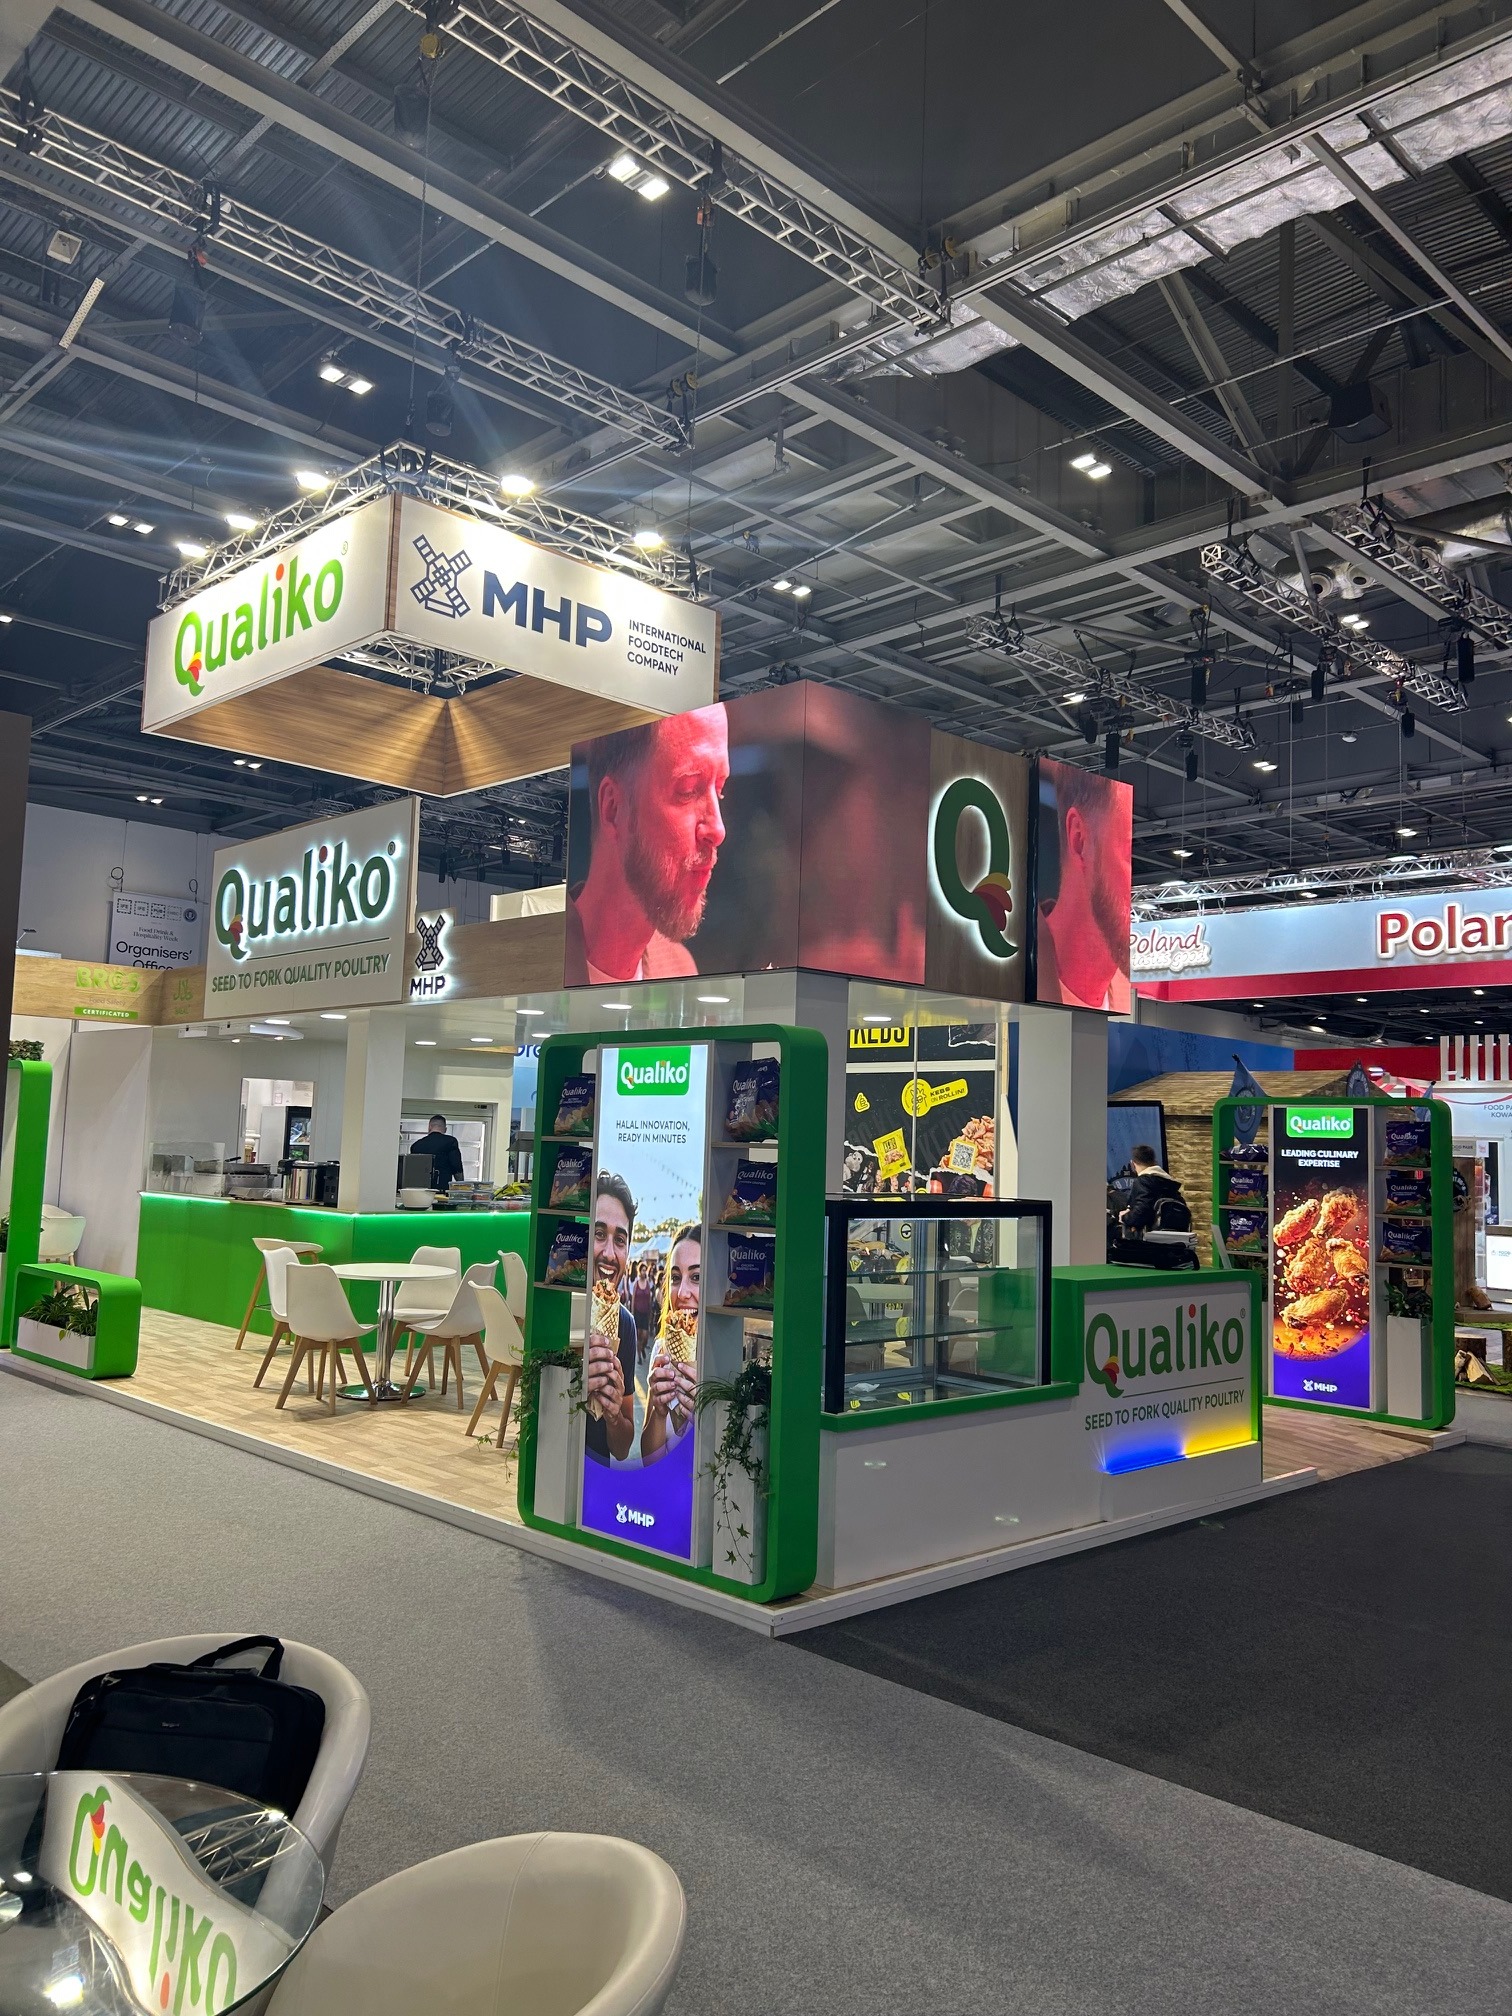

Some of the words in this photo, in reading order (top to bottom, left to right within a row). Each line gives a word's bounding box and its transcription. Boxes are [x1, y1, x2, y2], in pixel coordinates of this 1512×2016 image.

[482, 570, 613, 648] MHP
[174, 559, 343, 696] Qualiko
[629, 620, 706, 654] INTERNATIONAL
[628, 635, 683, 662] FOODTECH
[627, 651, 679, 676] COMPANY
[216, 842, 390, 960] Qualiko
[133, 932, 163, 940] Hospitality
[116, 941, 192, 960] Organisers'
[212, 975, 236, 993] SEED
[238, 973, 251, 990] TO
[253, 968, 281, 988] FORK
[284, 961, 332, 985] QUALITY
[334, 953, 390, 977] POULTRY
[410, 975, 446, 996] MHP
[83, 1009, 130, 1018] CERTIFICATED
[621, 1060, 687, 1090] Qualiko
[616, 1120, 639, 1129] HALAL
[640, 1120, 690, 1131] INNOVATION,
[1290, 1116, 1350, 1134] Qualiko
[618, 1133, 641, 1142] READY
[643, 1133, 651, 1142] IN
[652, 1134, 687, 1144] MINUTES
[1281, 1149, 1316, 1158] LEADING
[1317, 1150, 1359, 1159] CULINARY
[1298, 1159, 1340, 1168] EXPERTISE
[737, 1170, 774, 1180] Qualiko
[555, 1233, 584, 1244] Qualiko
[730, 1248, 766, 1262] Qualiko
[1086, 1303, 1244, 1398] Qualiko
[1313, 1382, 1338, 1392] MHP
[1084, 1412, 1113, 1431] SEED
[1115, 1409, 1130, 1425] TO
[1132, 1404, 1160, 1422] FORK
[1161, 1396, 1203, 1419] QUALITY
[1204, 1389, 1245, 1409] POULTRY
[628, 1509, 655, 1527] MHP
